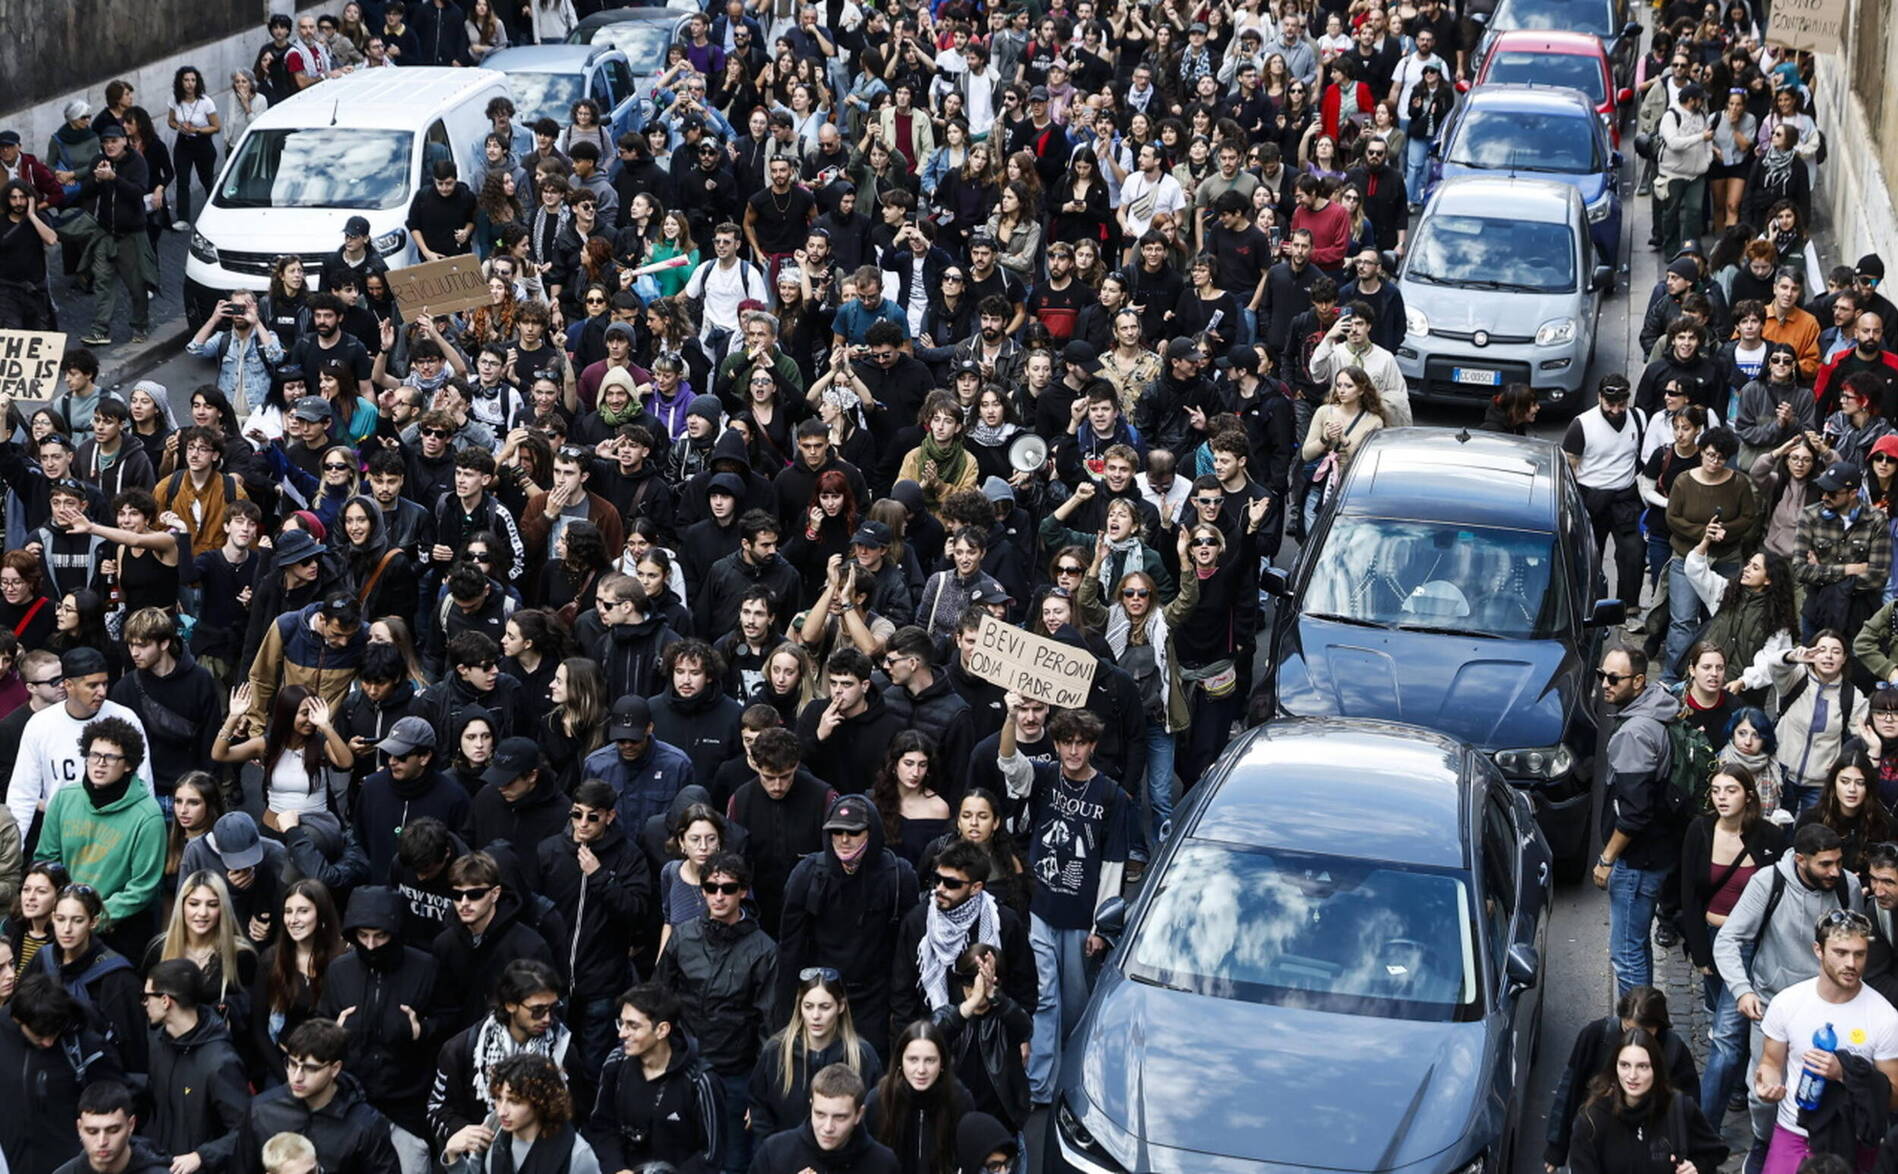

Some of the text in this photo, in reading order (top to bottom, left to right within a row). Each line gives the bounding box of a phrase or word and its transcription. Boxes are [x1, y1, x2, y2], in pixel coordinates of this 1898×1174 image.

[0, 336, 43, 359] HE
[34, 360, 58, 378] IS
[0, 377, 43, 398] EAR
[982, 621, 1094, 681] BEVI PERONI
[970, 651, 1003, 677] ODIA
[1007, 669, 1016, 686] I
[398, 882, 425, 902] NEW
[410, 900, 446, 922] CITY
